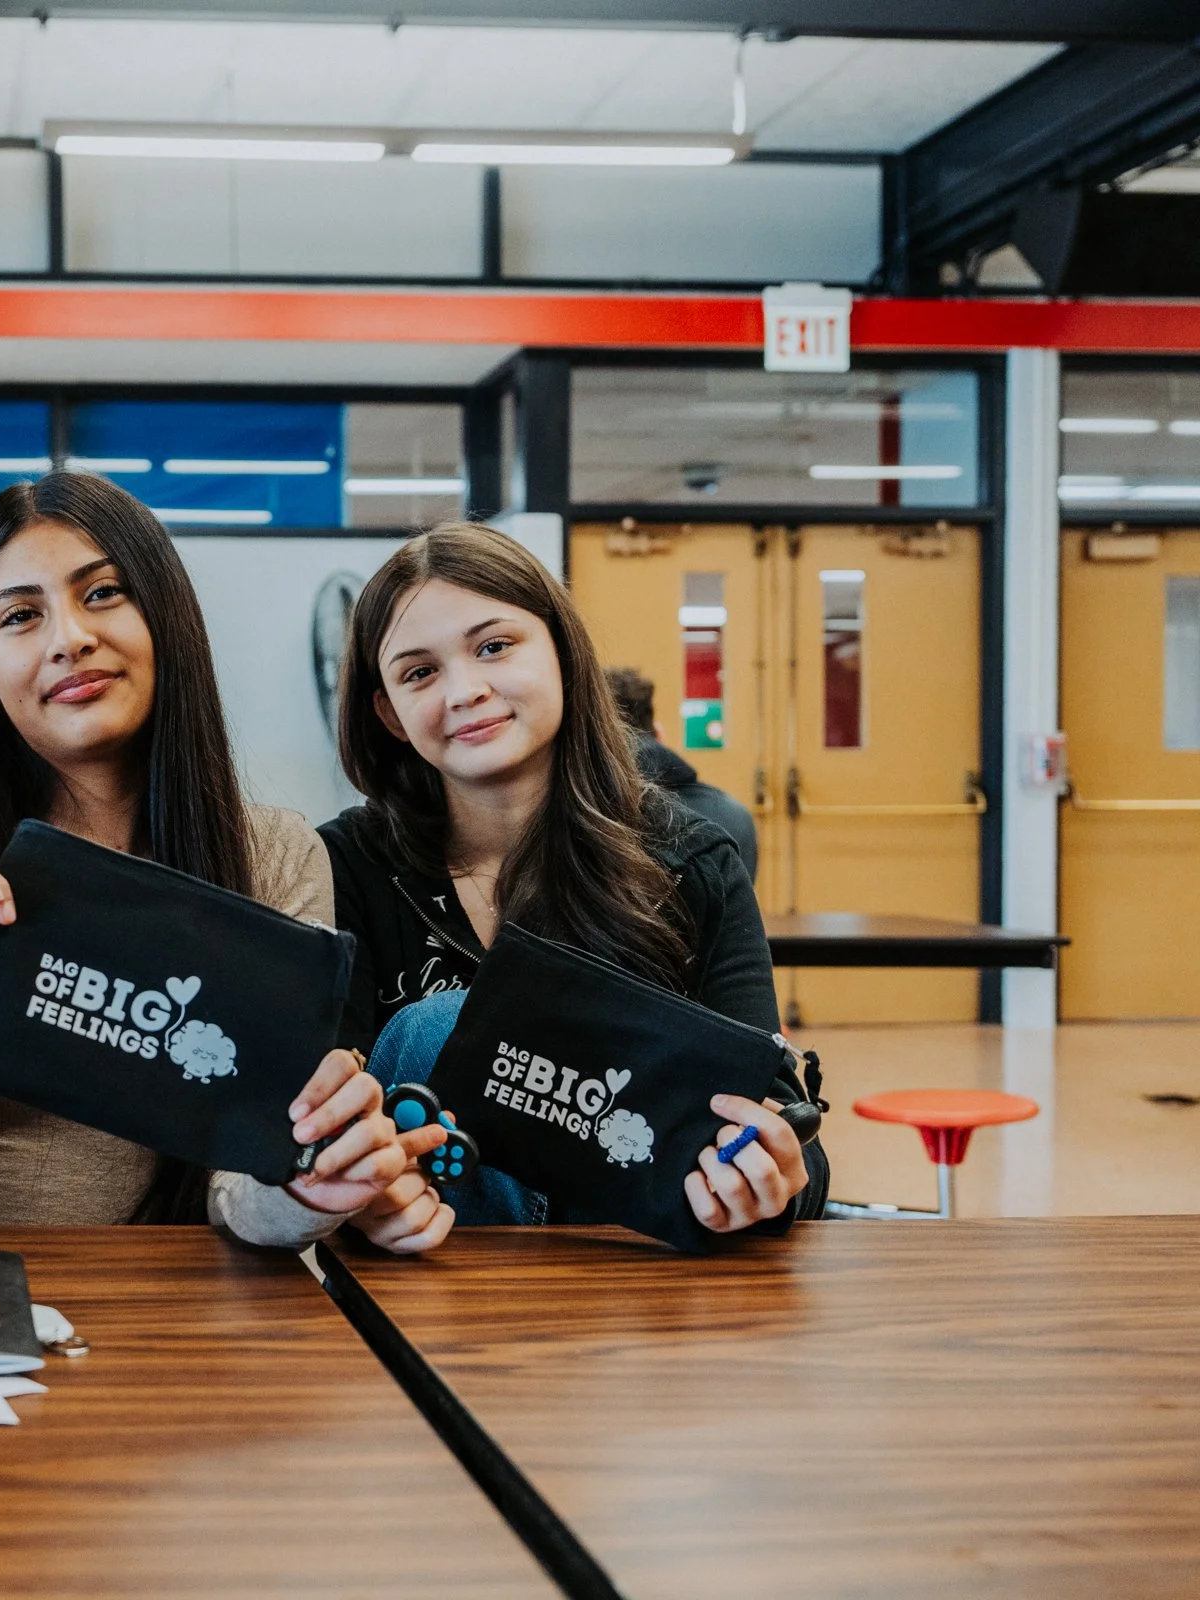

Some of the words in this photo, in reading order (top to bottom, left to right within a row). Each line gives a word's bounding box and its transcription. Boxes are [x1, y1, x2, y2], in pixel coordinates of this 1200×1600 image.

[776, 315, 838, 358] EXIT
[39, 952, 79, 978] BAG
[26, 994, 160, 1060] FEELINGS
[35, 970, 74, 1000] OF
[71, 966, 172, 1032] BIG
[497, 1041, 530, 1064] BAG
[483, 1078, 592, 1141] FEELINGS
[492, 1057, 527, 1082] OF
[523, 1054, 607, 1116] BIG
